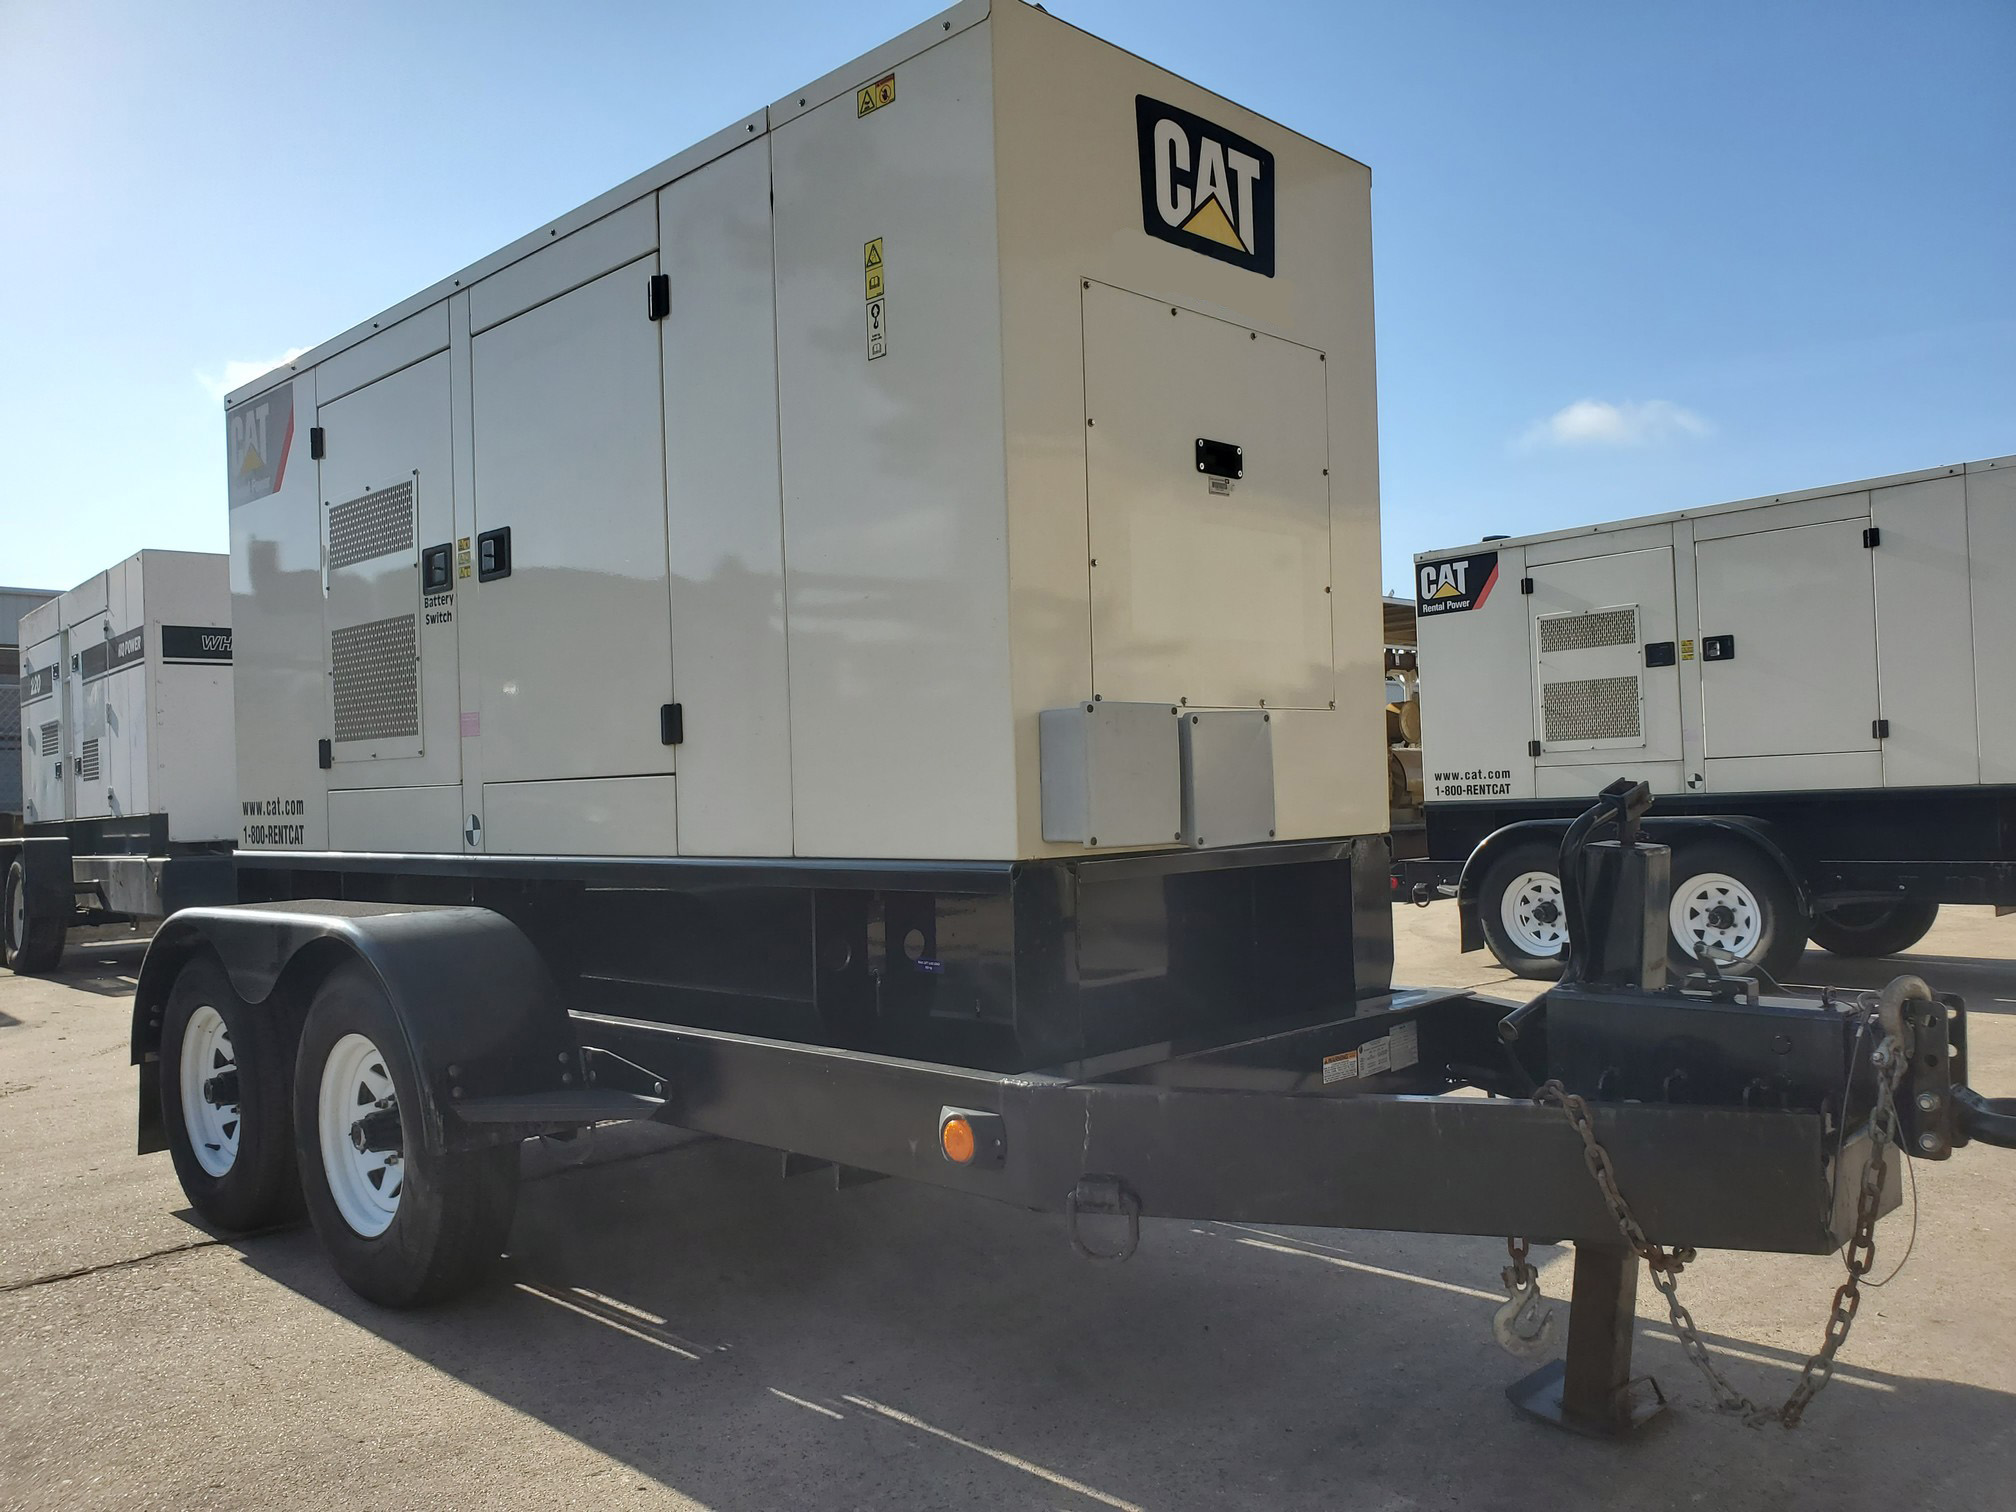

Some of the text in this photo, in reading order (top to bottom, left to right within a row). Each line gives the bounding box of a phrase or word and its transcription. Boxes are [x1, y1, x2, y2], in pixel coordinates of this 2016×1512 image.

[1154, 118, 1260, 256] CAT
[231, 402, 270, 479] CAT
[1420, 560, 1469, 600] CAT
[424, 593, 454, 609] Battery
[1422, 600, 1471, 613] Rental Power
[425, 610, 452, 625] Switch
[1434, 769, 1511, 781] www.cat.com
[1435, 783, 1511, 796] 1-800-RENTCAT
[242, 796, 304, 816] www.cat.com
[243, 825, 304, 845] 1-800-RENTCAT
